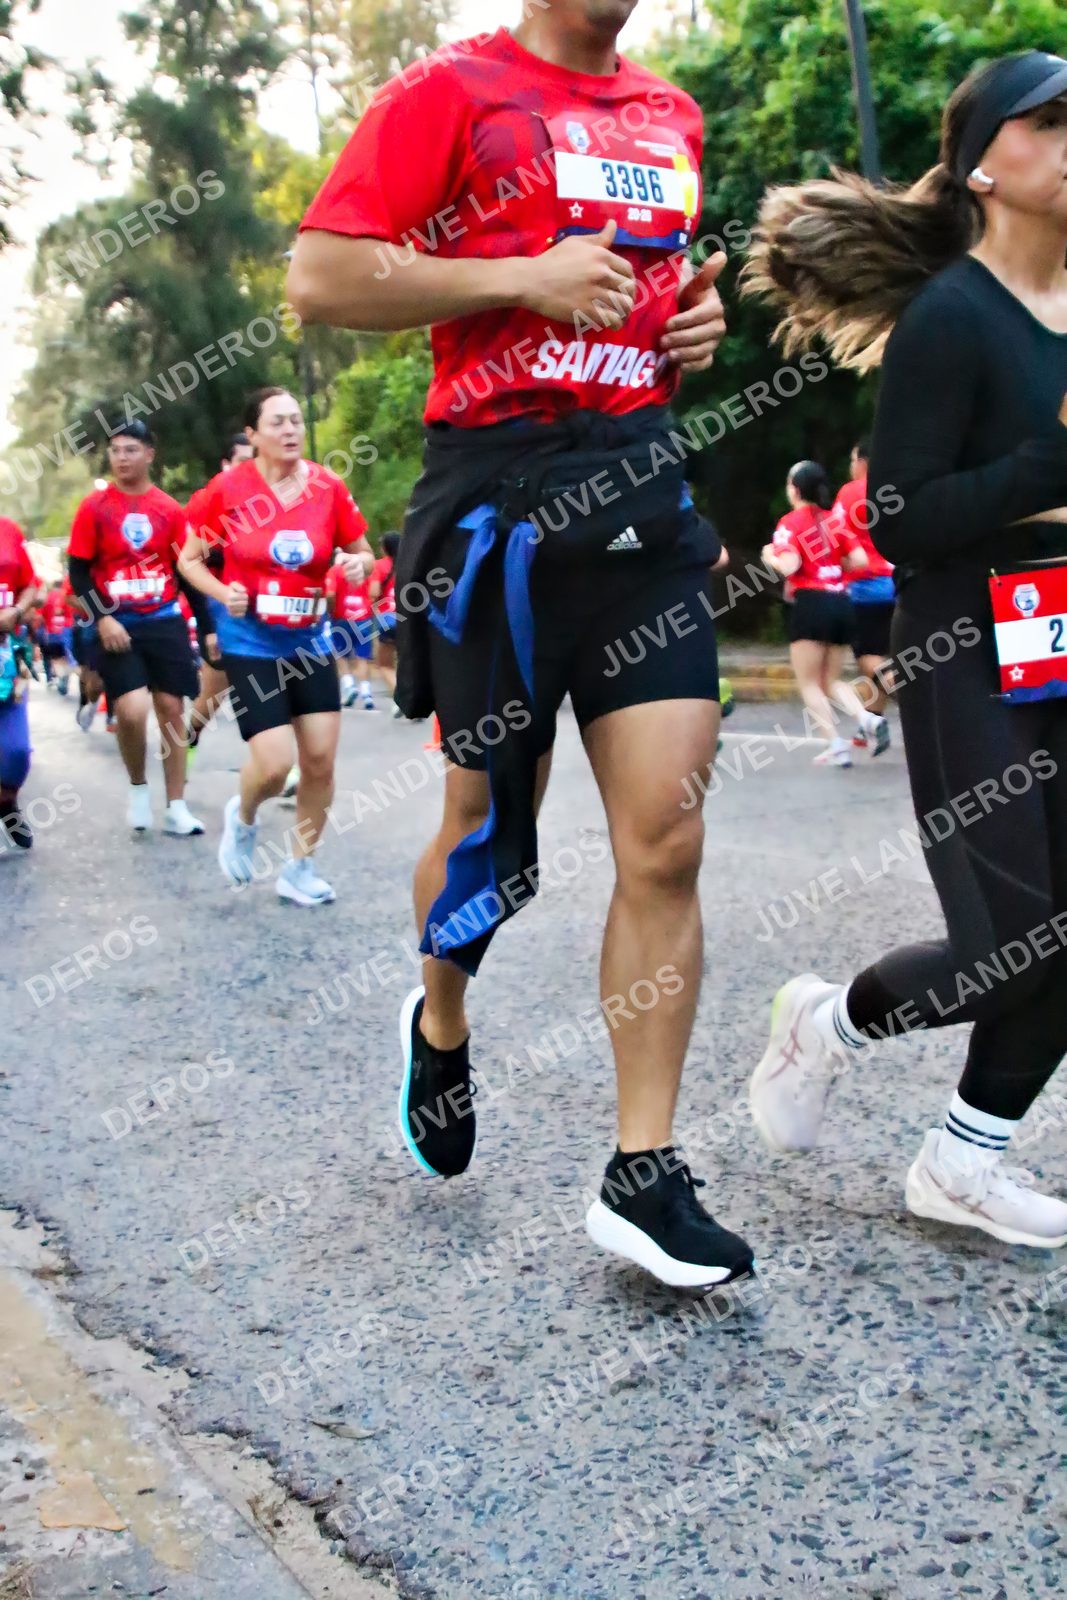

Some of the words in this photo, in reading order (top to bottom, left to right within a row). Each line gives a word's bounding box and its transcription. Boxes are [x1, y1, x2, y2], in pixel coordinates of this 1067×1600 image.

[601, 161, 664, 204] 3396
[607, 540, 643, 551] adidas
[1049, 618, 1065, 653] 2
